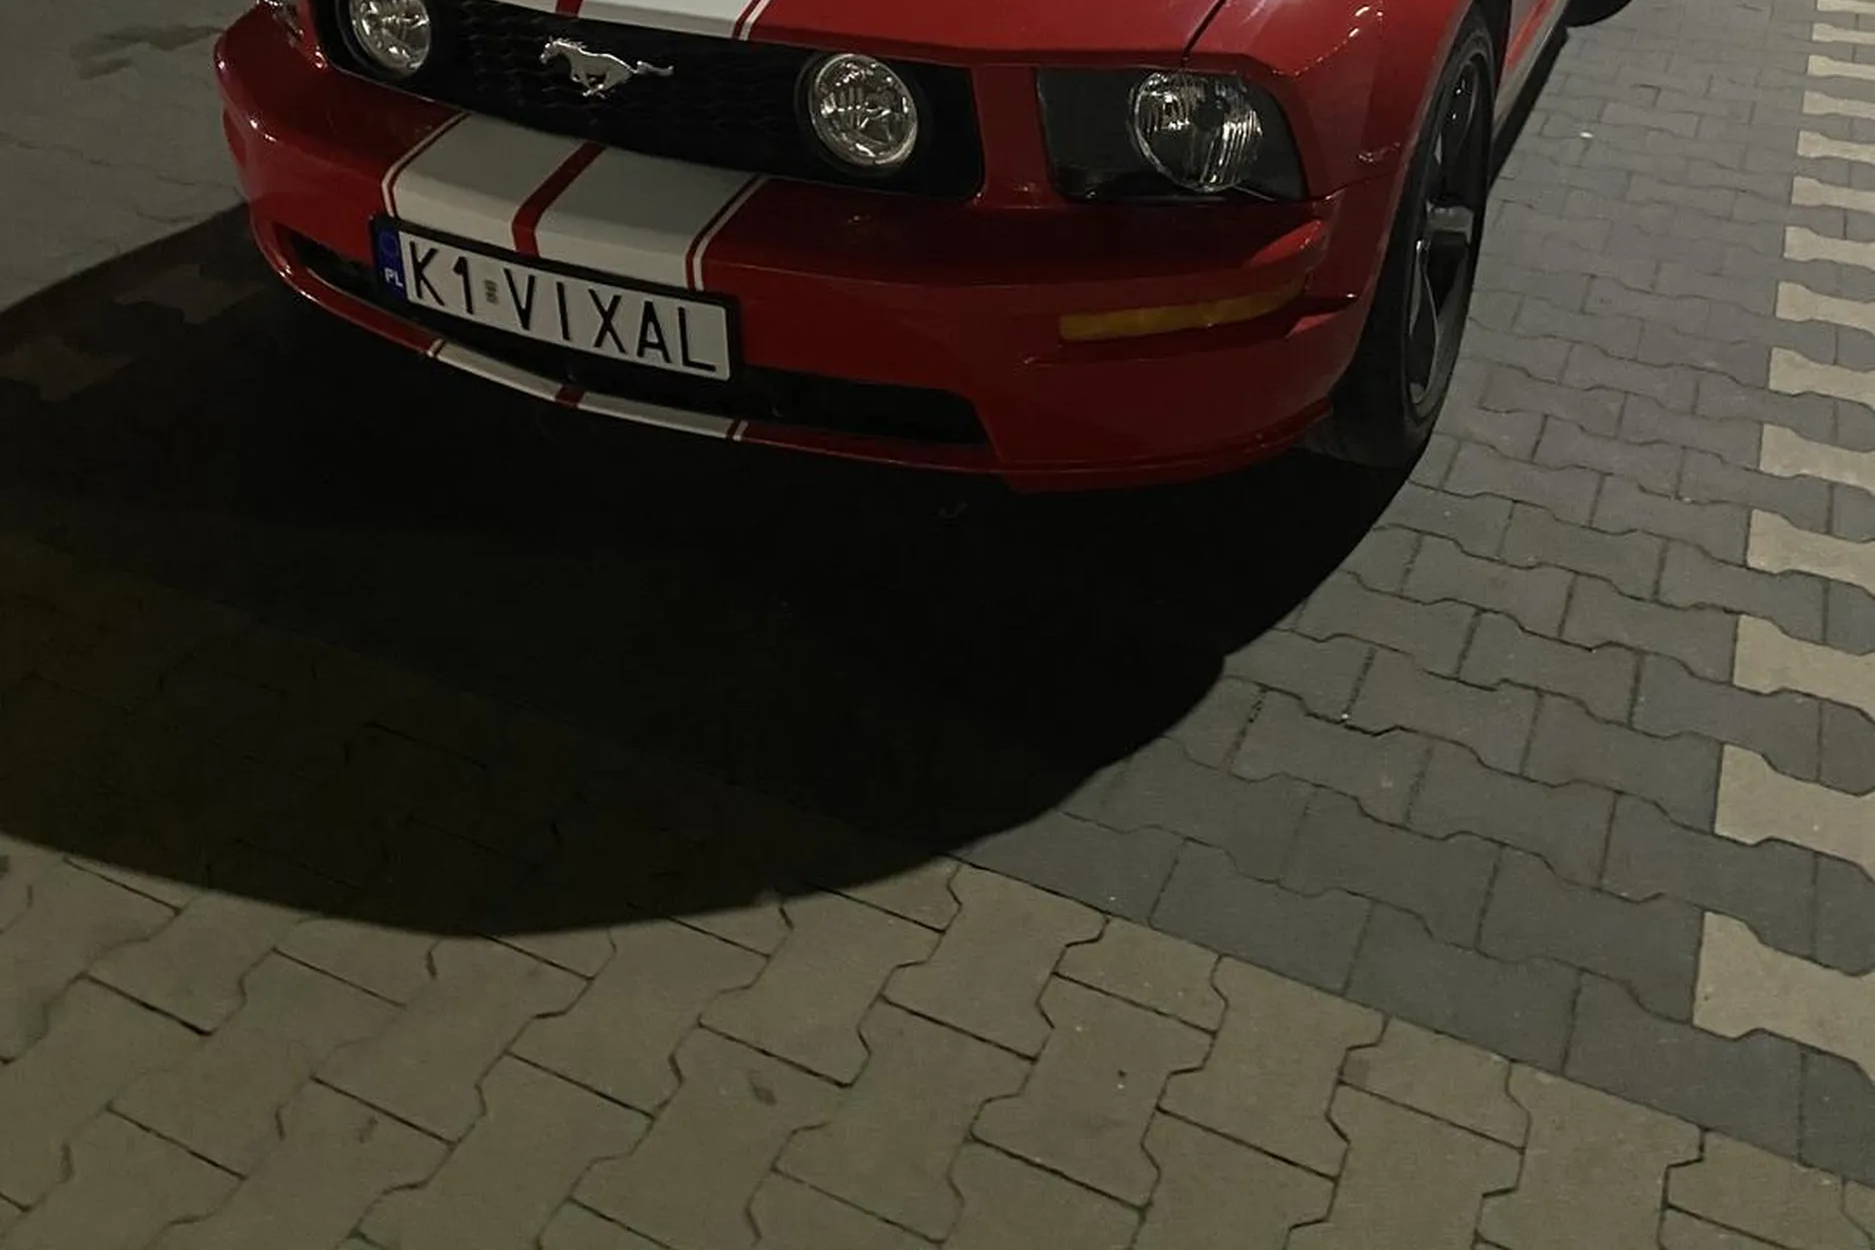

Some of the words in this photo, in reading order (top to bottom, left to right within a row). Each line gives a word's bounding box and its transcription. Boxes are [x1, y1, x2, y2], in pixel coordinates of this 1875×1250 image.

[384, 268, 403, 287] PL
[408, 240, 474, 316] K1
[503, 267, 717, 372] VIXAL
